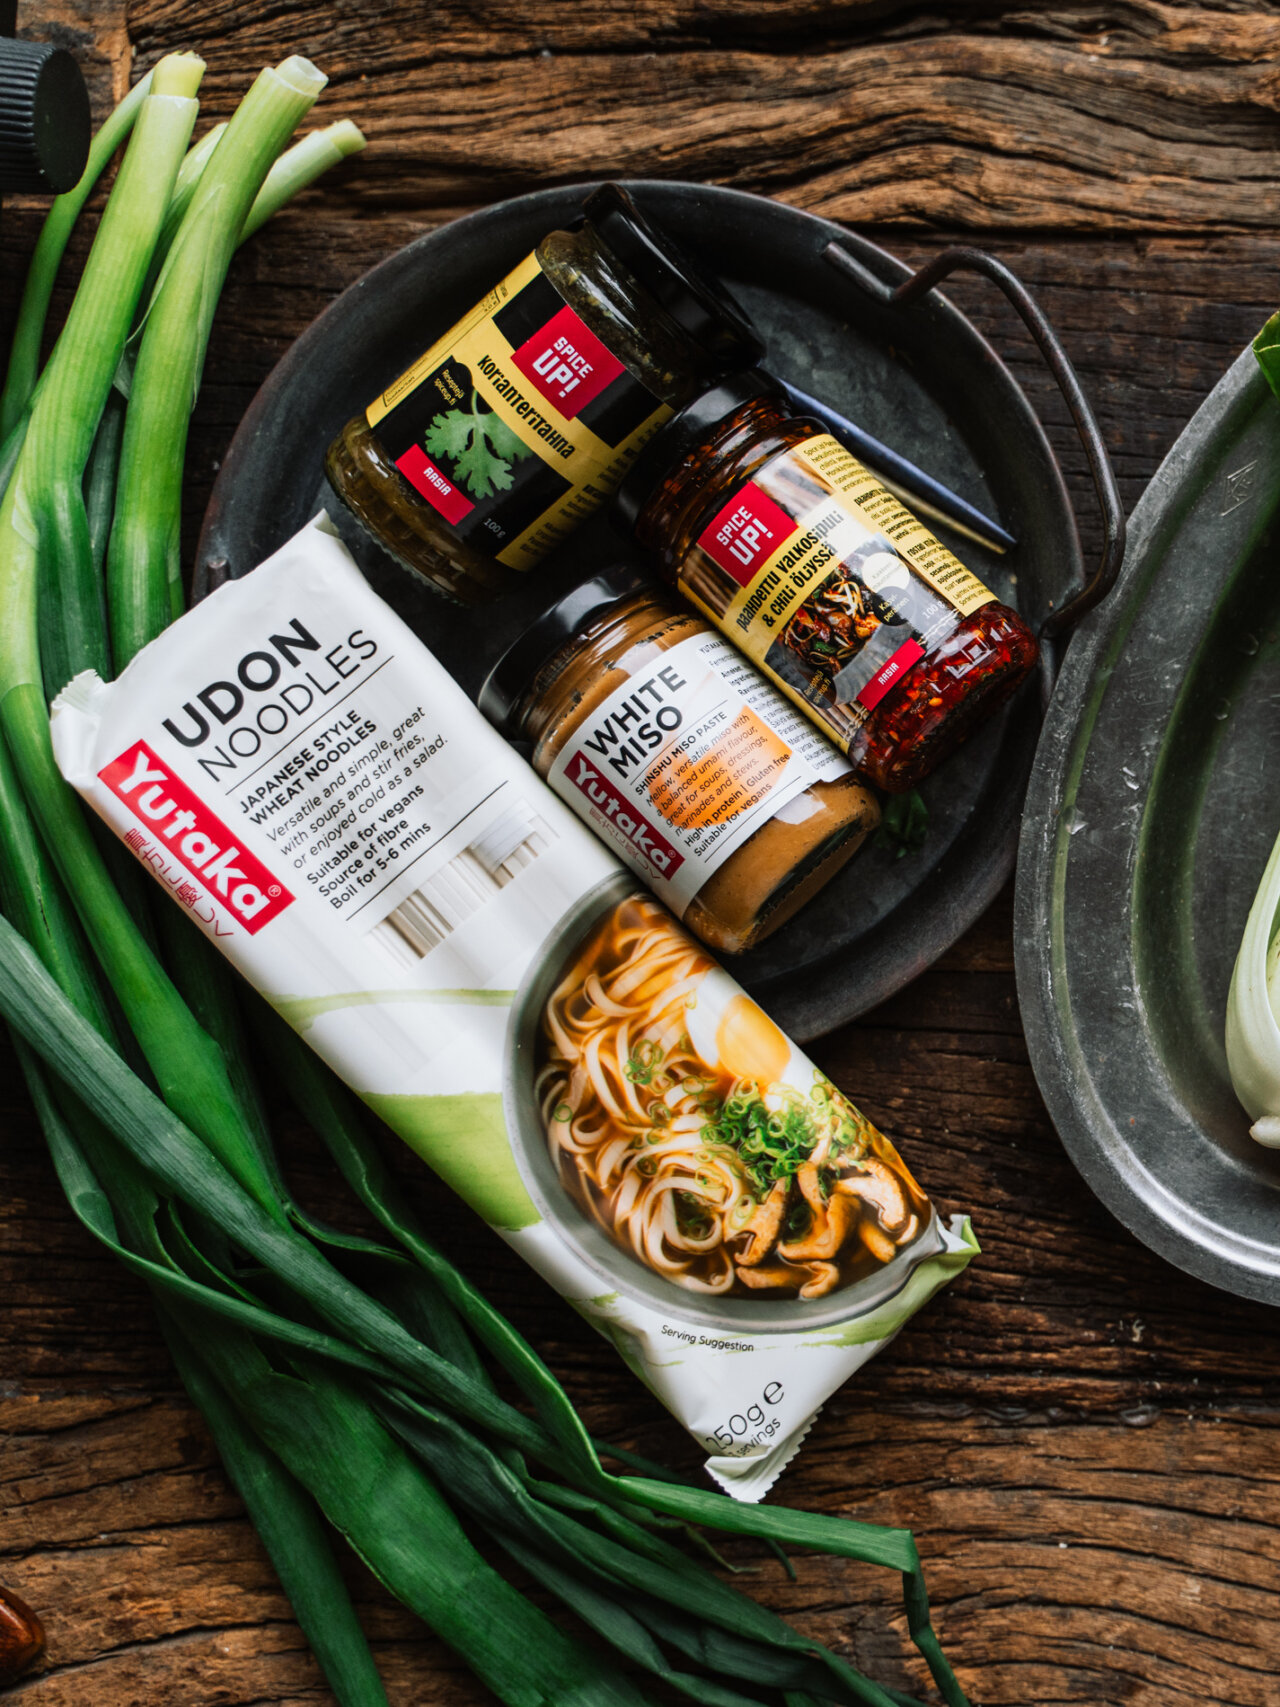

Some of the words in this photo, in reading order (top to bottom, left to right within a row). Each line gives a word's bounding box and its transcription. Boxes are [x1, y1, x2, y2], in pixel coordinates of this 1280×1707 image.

[434, 378, 461, 406] spiceup.fi
[442, 368, 465, 399] Reseptejä
[532, 348, 580, 397] UP!
[553, 336, 593, 378] SPICE
[483, 517, 501, 532] 100
[716, 505, 752, 545] SPICE
[728, 517, 773, 565] UP!
[761, 613, 776, 627] &
[921, 603, 939, 620] 100
[161, 617, 321, 747] UDON
[197, 629, 377, 782] NOODLES
[584, 665, 686, 755] WHITE
[240, 747, 314, 813] JAPANESE
[312, 709, 361, 751] STYLE
[249, 777, 304, 824] WHEAT
[304, 720, 376, 781] NOODLES
[266, 796, 321, 841] Versatile
[322, 771, 346, 798] and
[347, 740, 392, 776] simple,
[392, 706, 425, 741] great
[608, 706, 682, 778] MISO
[635, 755, 672, 795] SHINSHU
[670, 735, 696, 758] MISO
[695, 711, 727, 736] PASTE
[645, 776, 675, 807] Mellow,
[674, 746, 709, 777] versatile
[710, 727, 731, 746] miso
[731, 714, 749, 729] with
[656, 808, 662, 816] a
[660, 770, 698, 810] balanced
[697, 747, 727, 774] umami
[727, 725, 757, 749] flavour,
[665, 802, 686, 828] great
[685, 789, 698, 805] for
[727, 735, 768, 766] dressings,
[280, 831, 308, 855] with
[309, 798, 345, 833] soups
[346, 774, 371, 800] and
[372, 757, 391, 779] stir
[393, 734, 424, 761] fries,
[293, 853, 306, 868] or
[309, 809, 357, 855] enjoyed
[358, 784, 385, 813] cold
[387, 774, 402, 790] as
[403, 766, 412, 776] a
[412, 734, 447, 768] salad.
[306, 841, 358, 884] Suitable
[357, 822, 377, 841] for
[378, 785, 424, 822] vegans
[668, 794, 715, 836] marinades
[715, 776, 732, 795] and
[732, 758, 759, 780] stews.
[683, 826, 704, 847] High
[701, 818, 712, 828] in
[711, 790, 742, 821] protein
[745, 764, 775, 787] Gluten
[772, 753, 790, 766] free
[693, 823, 726, 856] Suitable
[725, 809, 740, 823] for
[740, 783, 772, 809] vegans
[318, 859, 363, 896] Source
[363, 842, 377, 859] of
[376, 820, 408, 846] fibre
[329, 883, 357, 909] Boil
[356, 868, 376, 887] for
[375, 847, 399, 870] 5-6
[399, 823, 430, 850] mins
[660, 1324, 696, 1344] Serving
[698, 1335, 753, 1351] Suggestion
